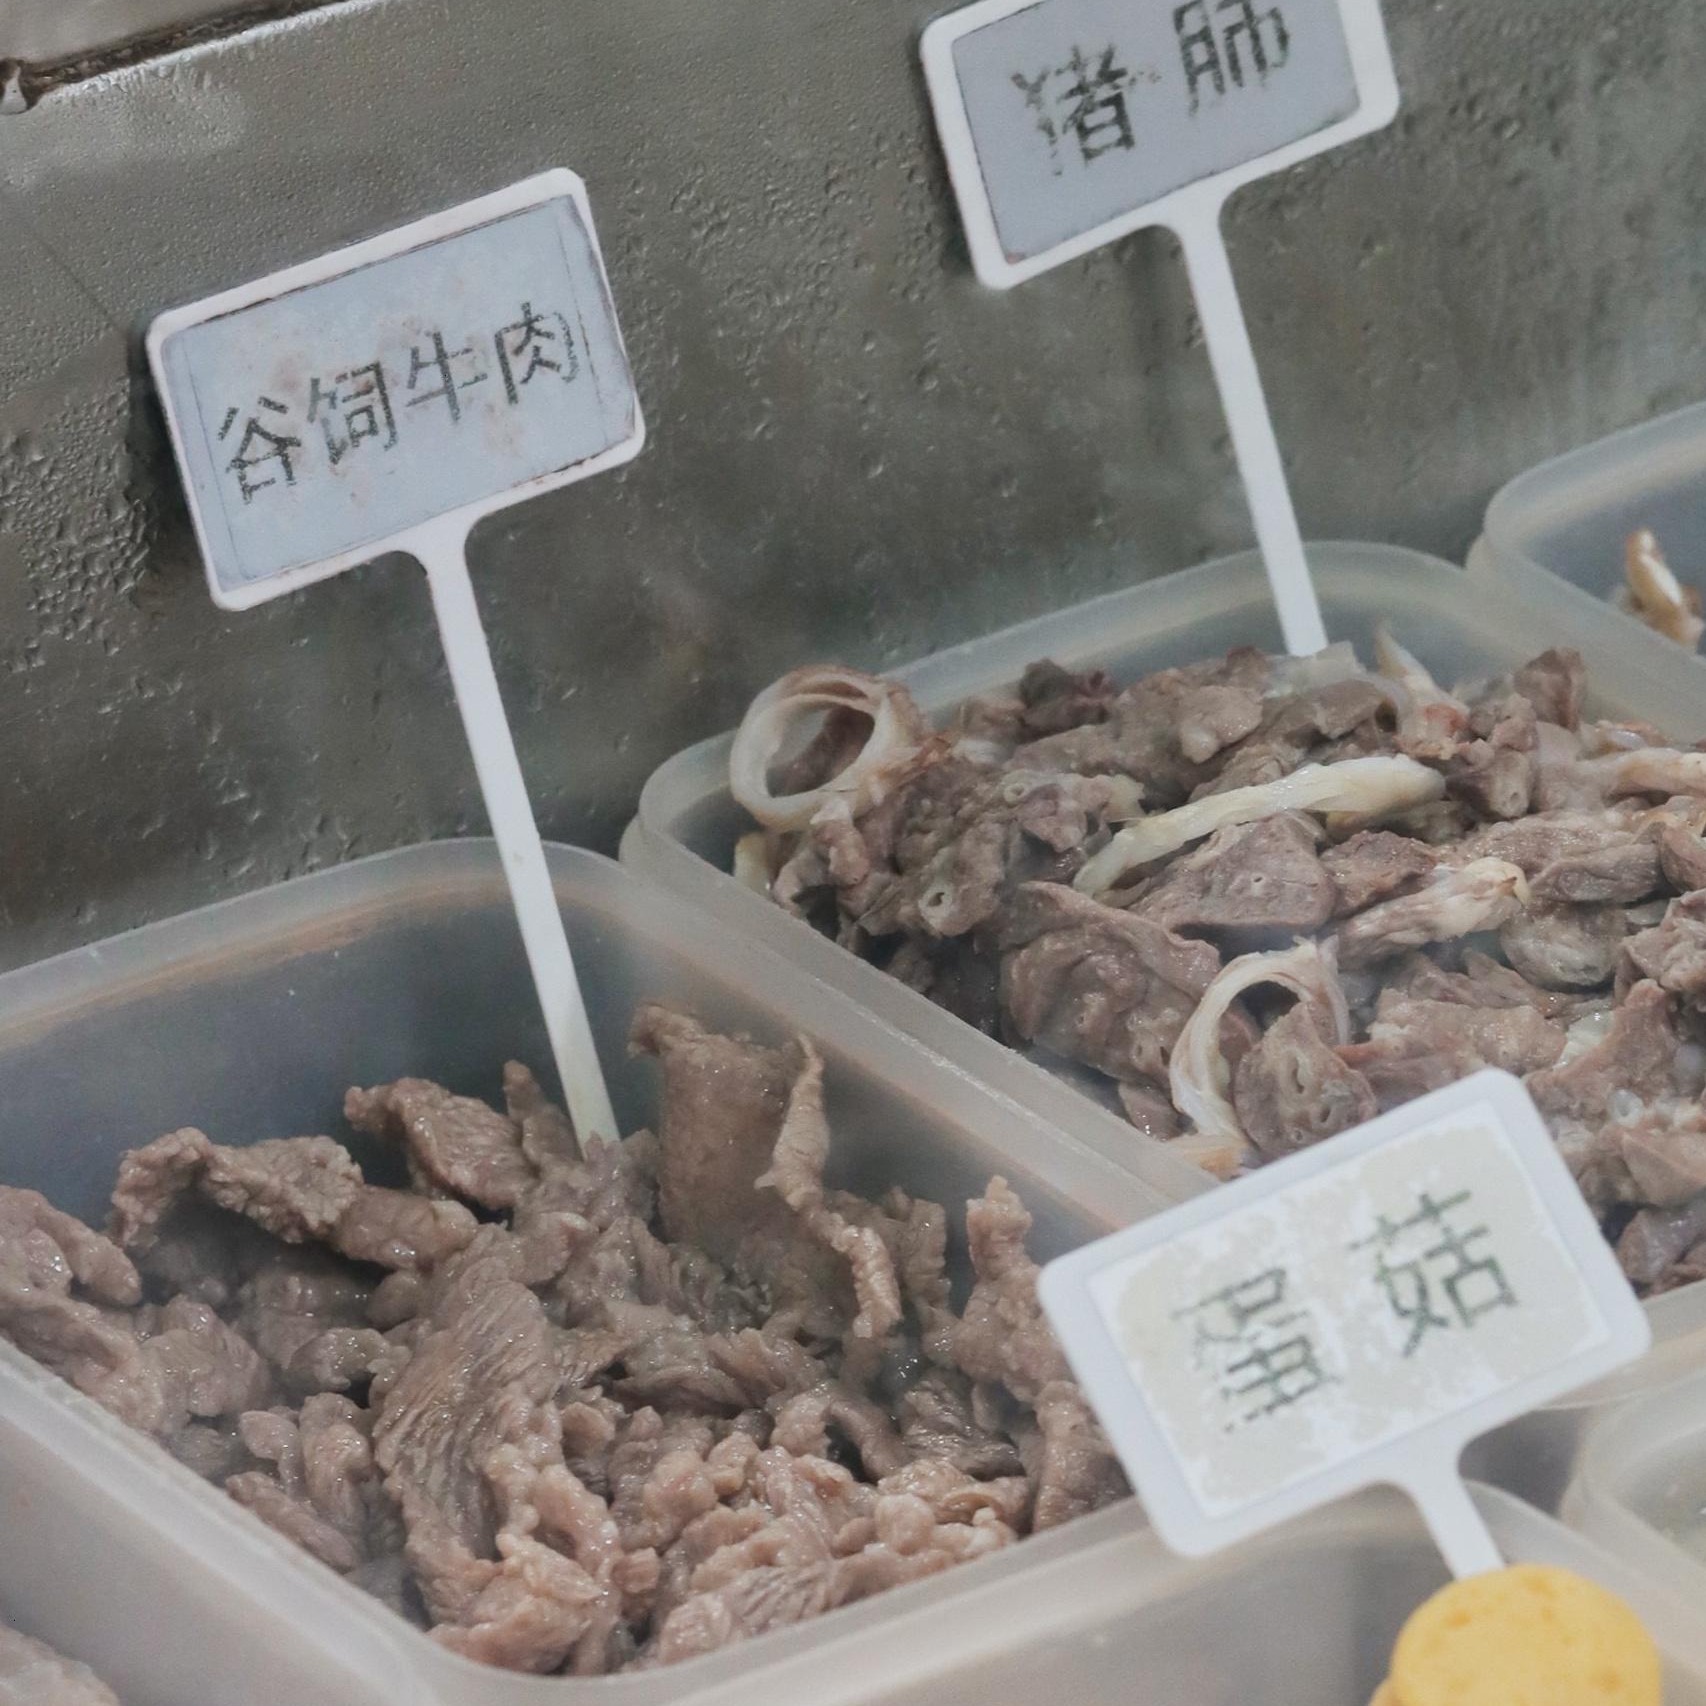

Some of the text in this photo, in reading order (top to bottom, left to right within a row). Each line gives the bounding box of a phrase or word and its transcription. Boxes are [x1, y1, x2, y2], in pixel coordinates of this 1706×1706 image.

[218, 301, 579, 504] 谷饲牛肉
[1171, 1189, 1520, 1433] 蛋菇
